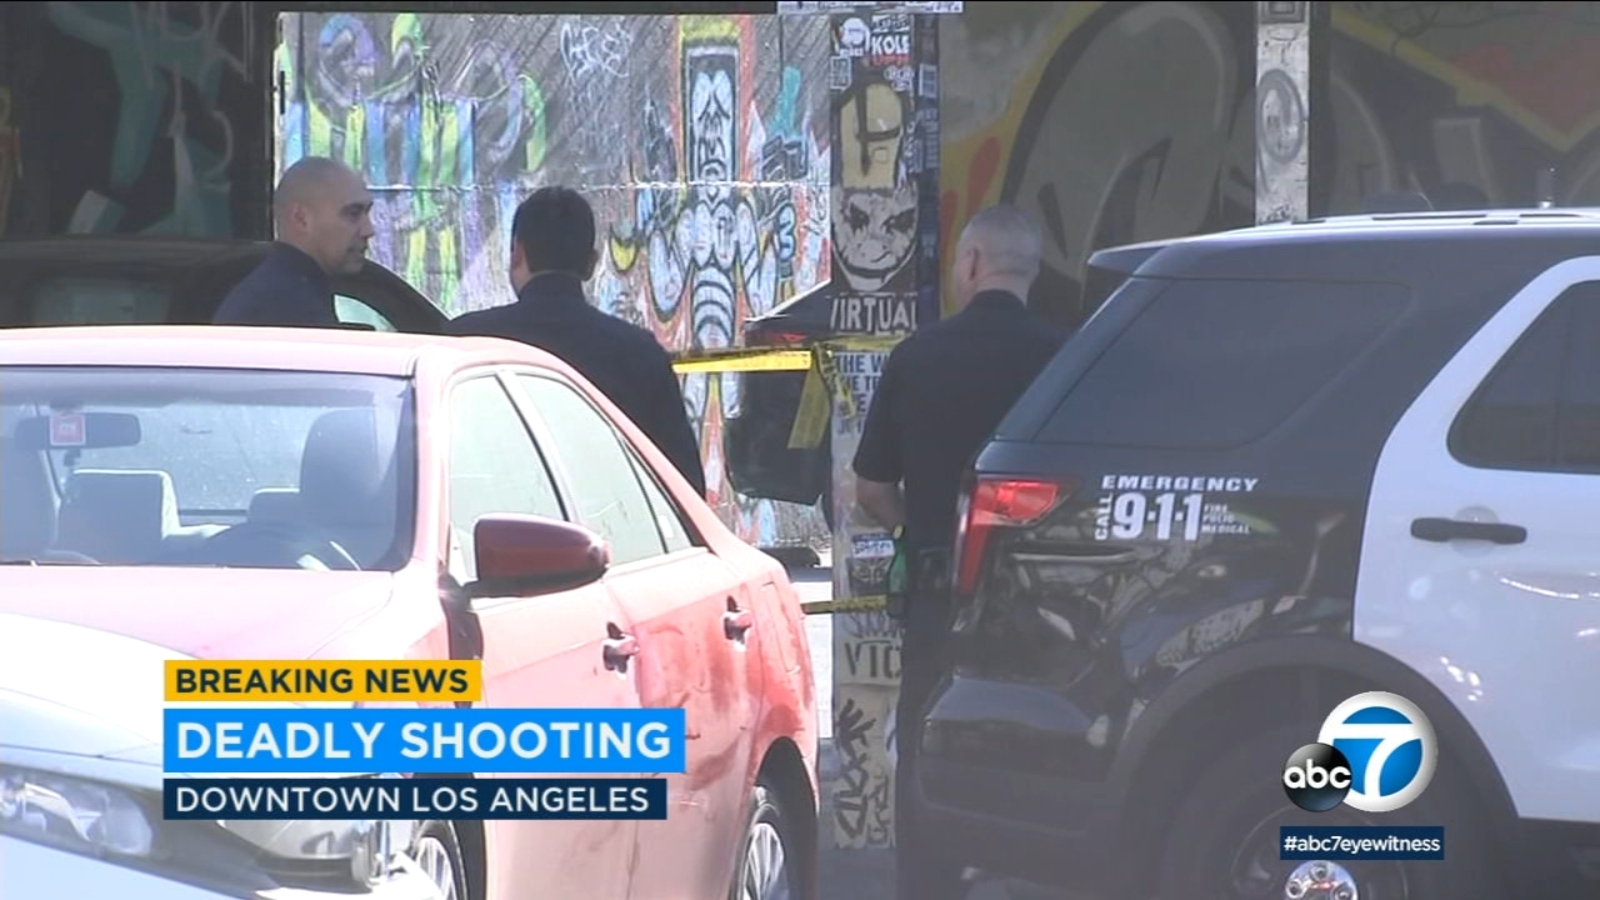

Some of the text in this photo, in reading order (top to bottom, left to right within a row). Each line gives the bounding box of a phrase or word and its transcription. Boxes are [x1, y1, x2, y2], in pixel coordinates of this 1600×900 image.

[1102, 475, 1258, 492] EMERGENCY
[1204, 503, 1228, 512] FIRE
[1095, 493, 1114, 541] CALL
[1201, 524, 1250, 534] MEDICAL
